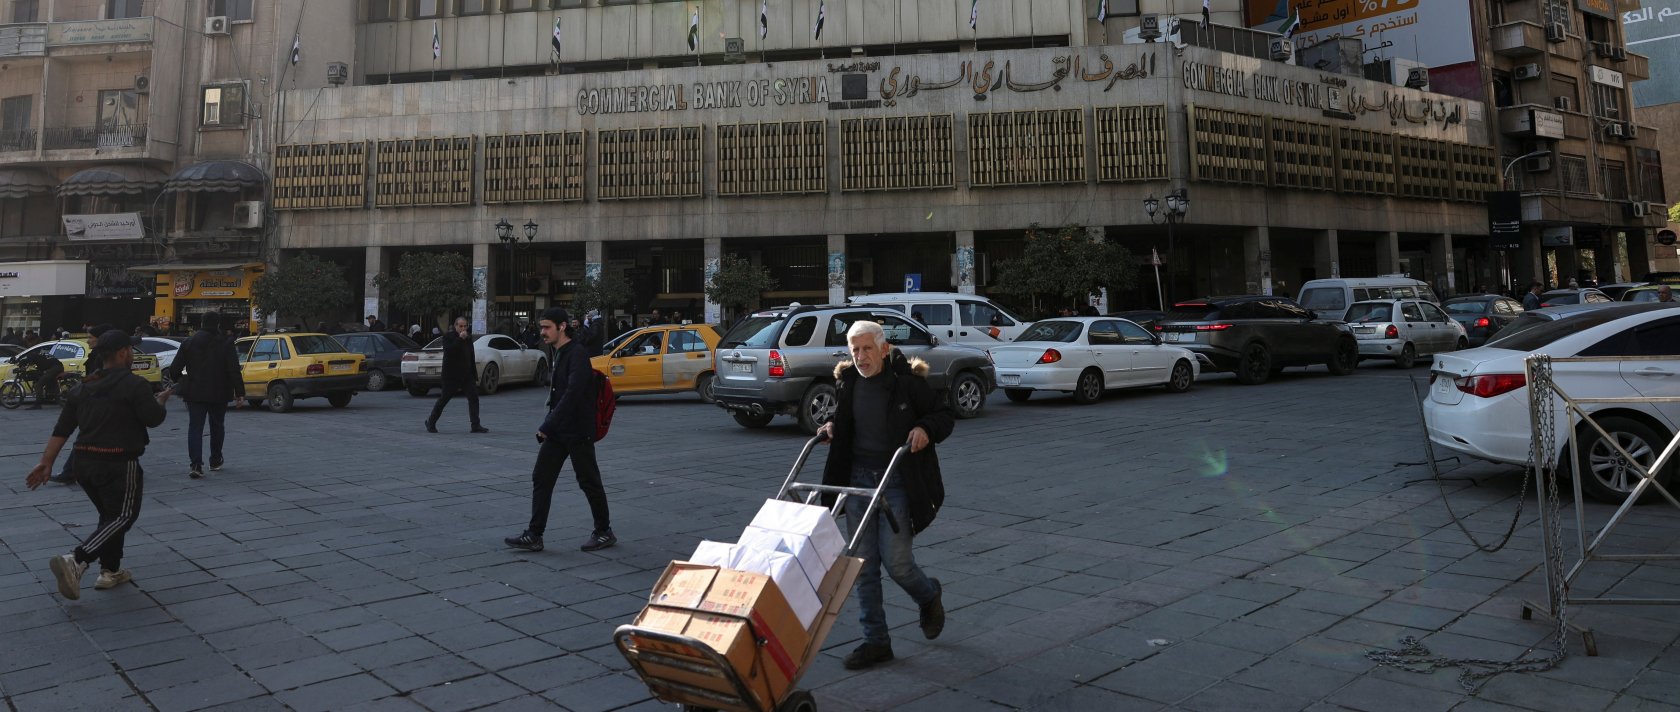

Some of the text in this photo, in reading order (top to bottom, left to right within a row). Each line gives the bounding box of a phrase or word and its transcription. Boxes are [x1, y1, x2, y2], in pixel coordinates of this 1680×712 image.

[1369, 12, 1418, 38] استخدم
[577, 76, 829, 115] COMMERCIAL BANK OF SYRIA
[880, 51, 1156, 108] المصرف التجاري السوري
[1182, 61, 1249, 98] COMMERCIAL
[1254, 73, 1280, 104] BANK
[1347, 86, 1461, 131] المصرف التجاري السوري
[905, 277, 914, 294] P
